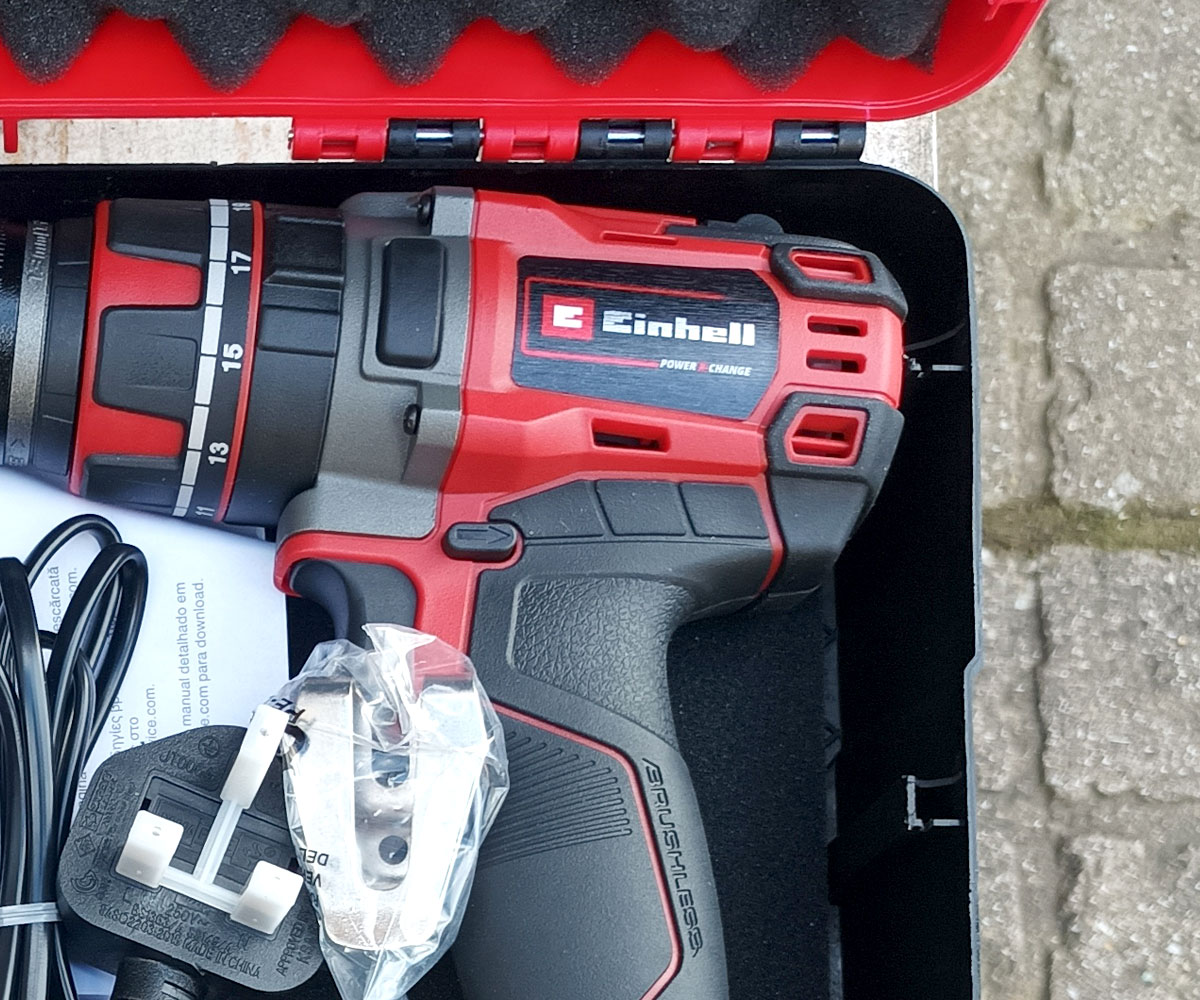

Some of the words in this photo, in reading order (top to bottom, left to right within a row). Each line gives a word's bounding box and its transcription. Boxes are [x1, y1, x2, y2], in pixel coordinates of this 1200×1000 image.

[230, 250, 252, 275] 17
[602, 310, 756, 347] Einhell
[221, 343, 244, 372] 15
[660, 358, 697, 372] POWER
[207, 442, 230, 464] 13
[175, 581, 186, 603] em
[191, 578, 206, 648] download.
[175, 606, 189, 674] detalhado
[197, 650, 211, 681] para
[178, 677, 192, 726] manual
[642, 757, 703, 957] BRUSHLESS
